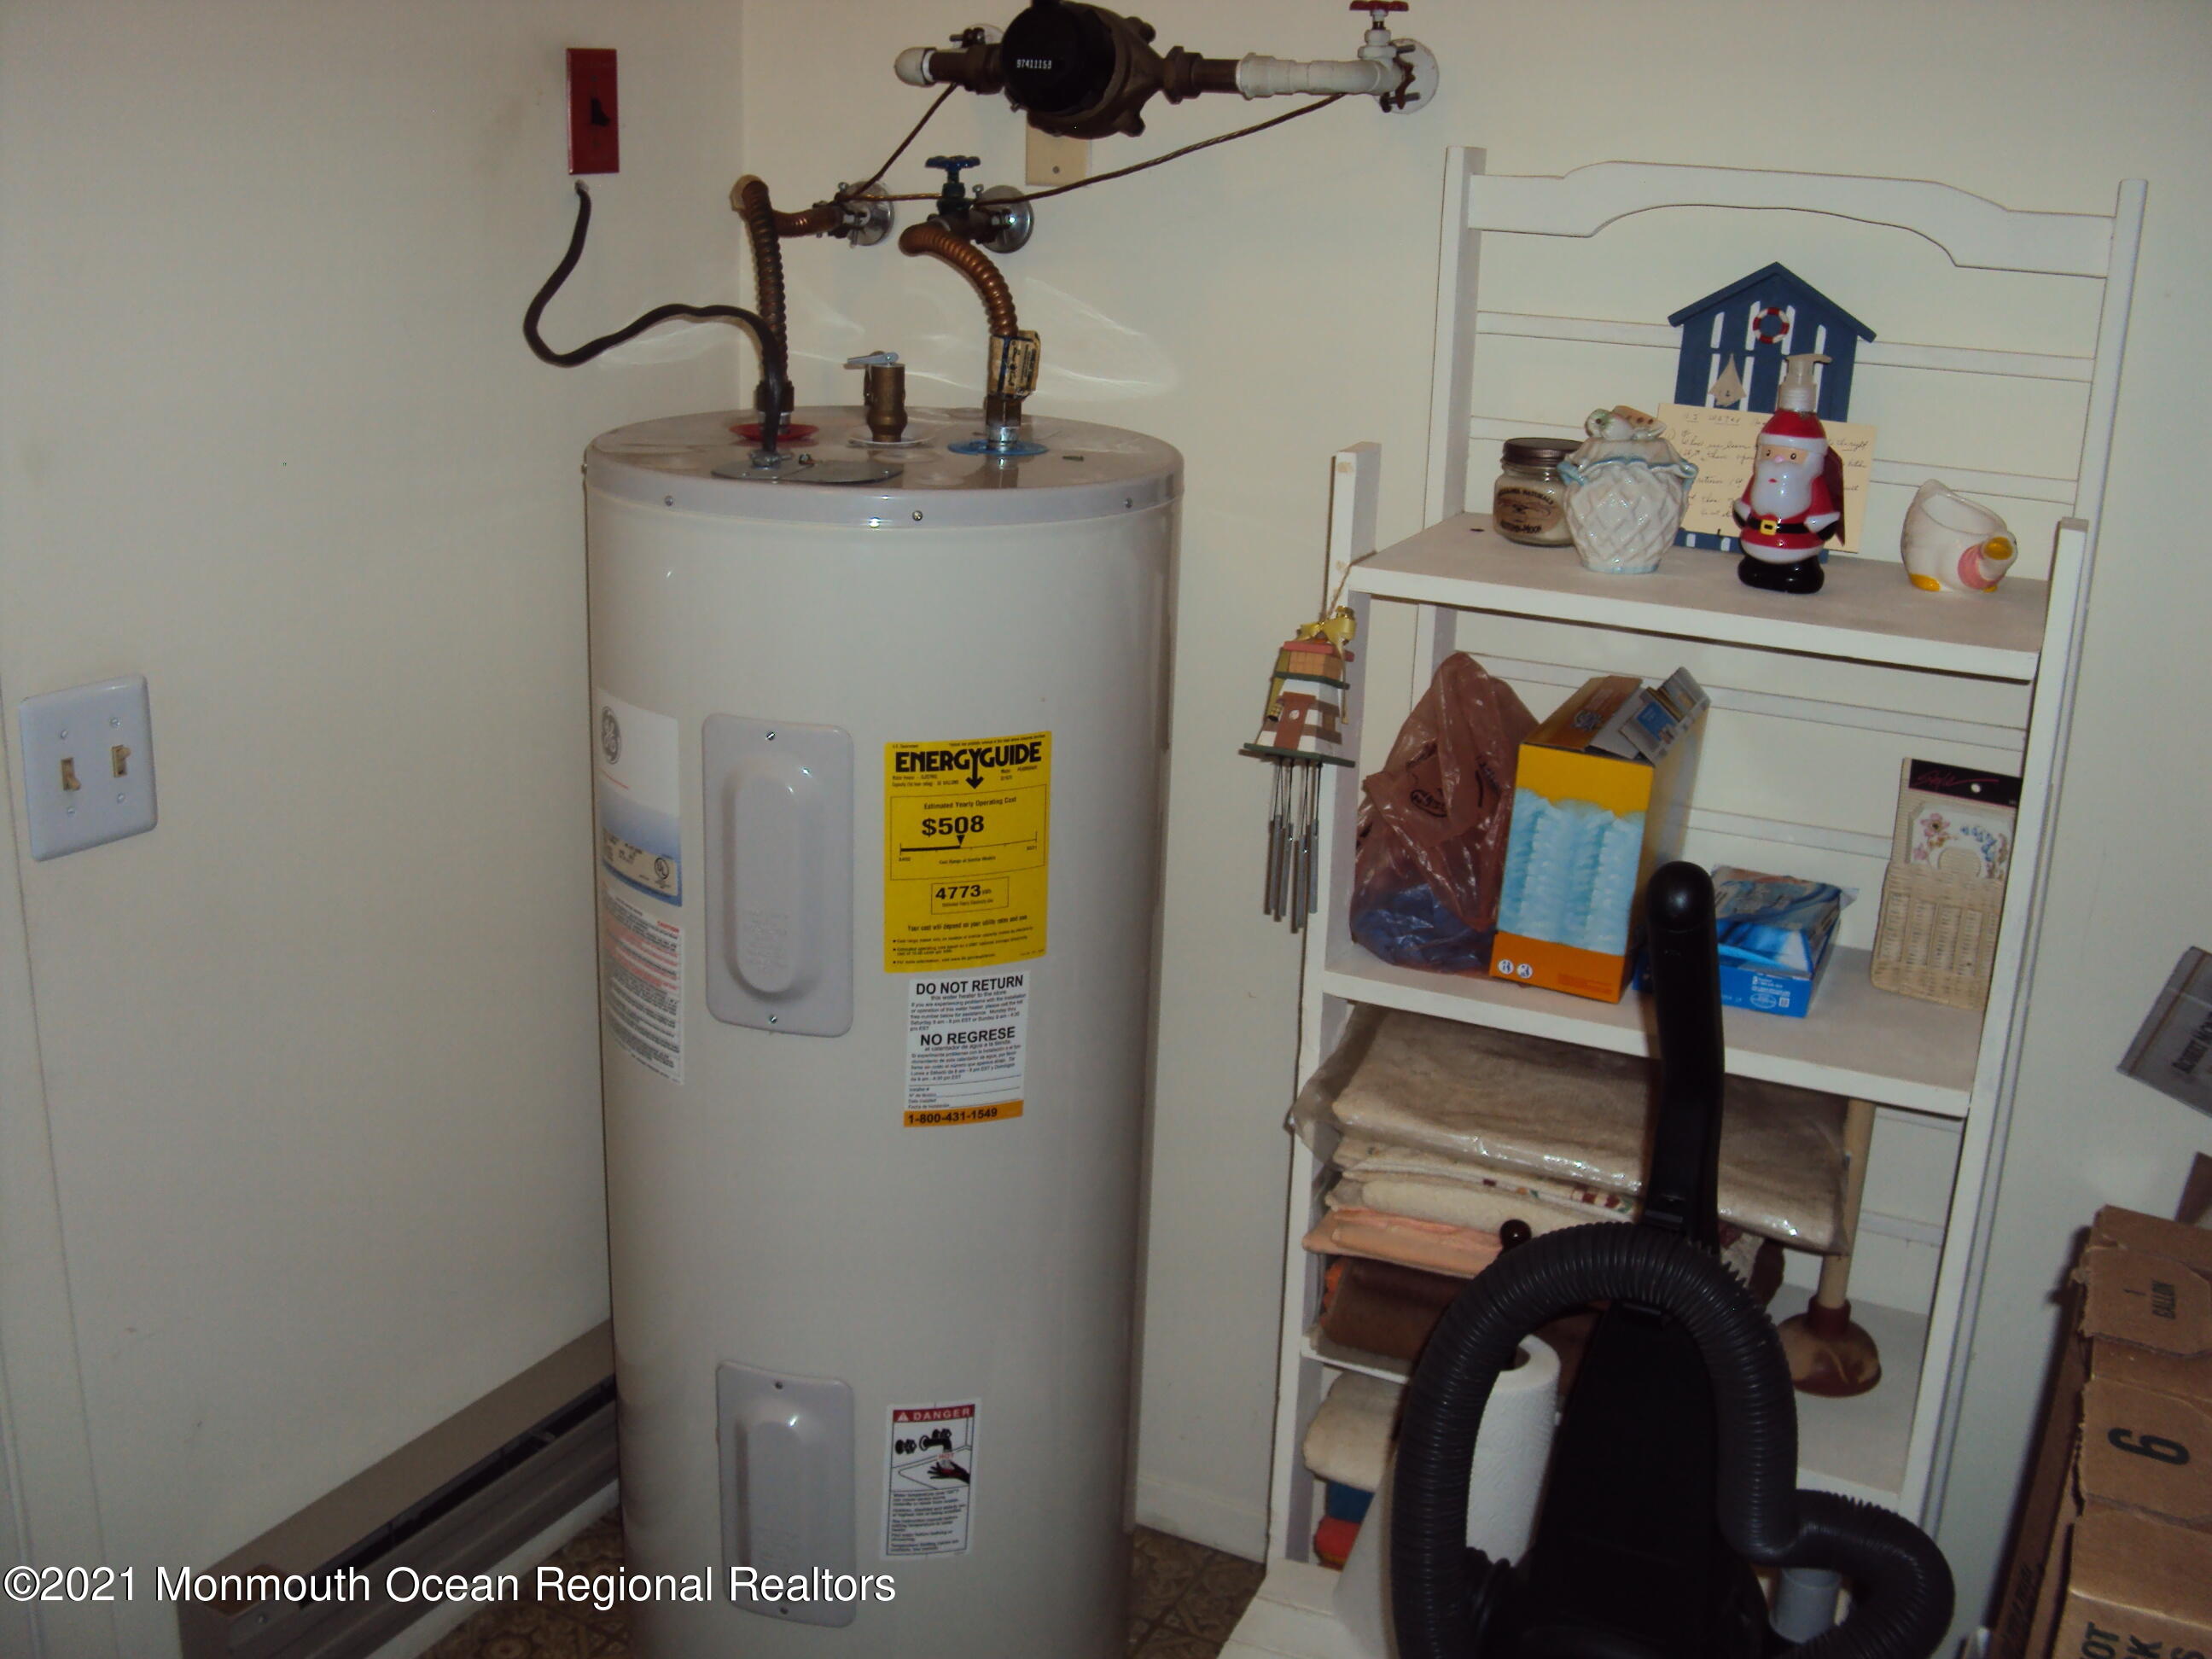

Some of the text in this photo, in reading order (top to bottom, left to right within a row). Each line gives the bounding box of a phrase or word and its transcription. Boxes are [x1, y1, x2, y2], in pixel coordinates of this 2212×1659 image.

[895, 741, 1042, 777] ENERGYGUIDE
[975, 798, 1003, 807] Operating
[922, 815, 984, 837] $508
[935, 884, 981, 899] 4773
[917, 975, 1024, 995] DO NOT RETURN
[921, 1026, 1016, 1046] NO REGRESE
[908, 1107, 998, 1125] 1-800-431-1549
[2150, 1278, 2177, 1323] GALLON
[912, 1407, 971, 1422] DANGER
[2107, 1427, 2191, 1467] 6
[2081, 1621, 2120, 1659] OT
